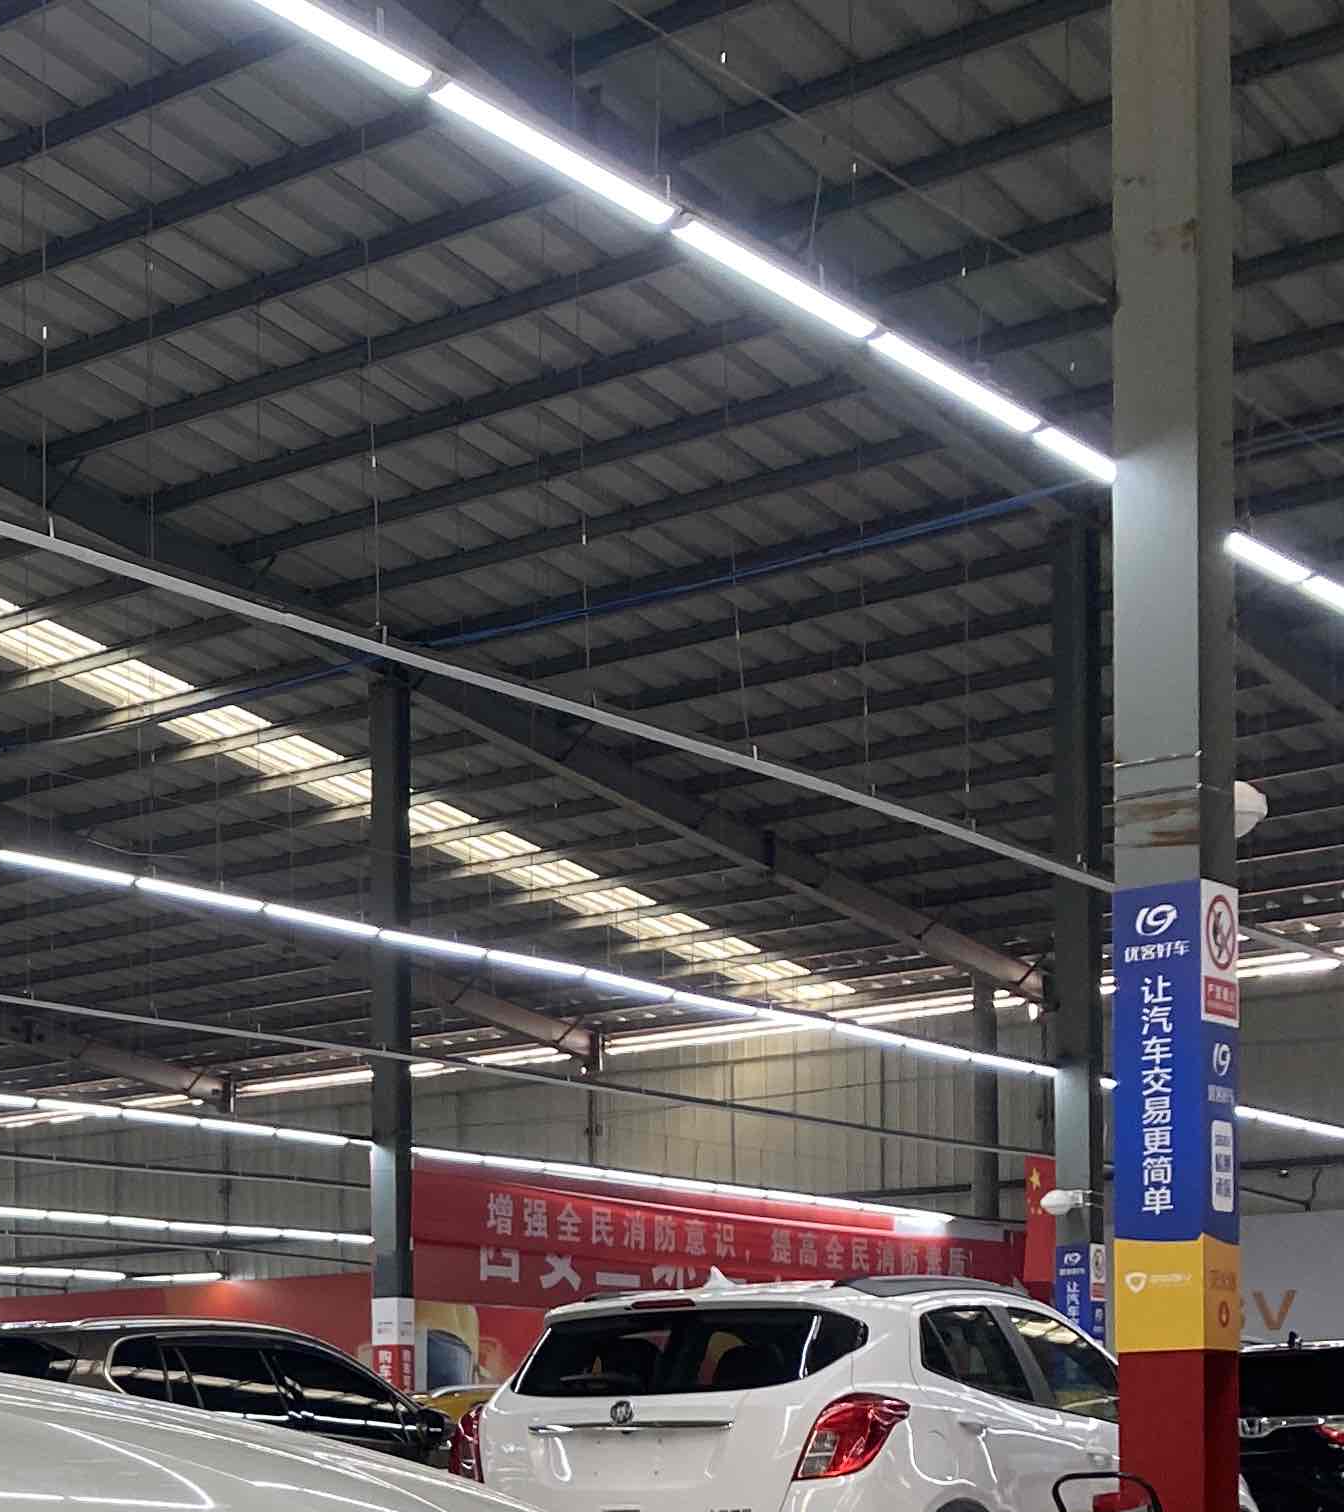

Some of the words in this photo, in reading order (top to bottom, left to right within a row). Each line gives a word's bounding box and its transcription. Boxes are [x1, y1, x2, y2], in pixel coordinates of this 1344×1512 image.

[1141, 975, 1174, 1216] 让汽车交易更简单
